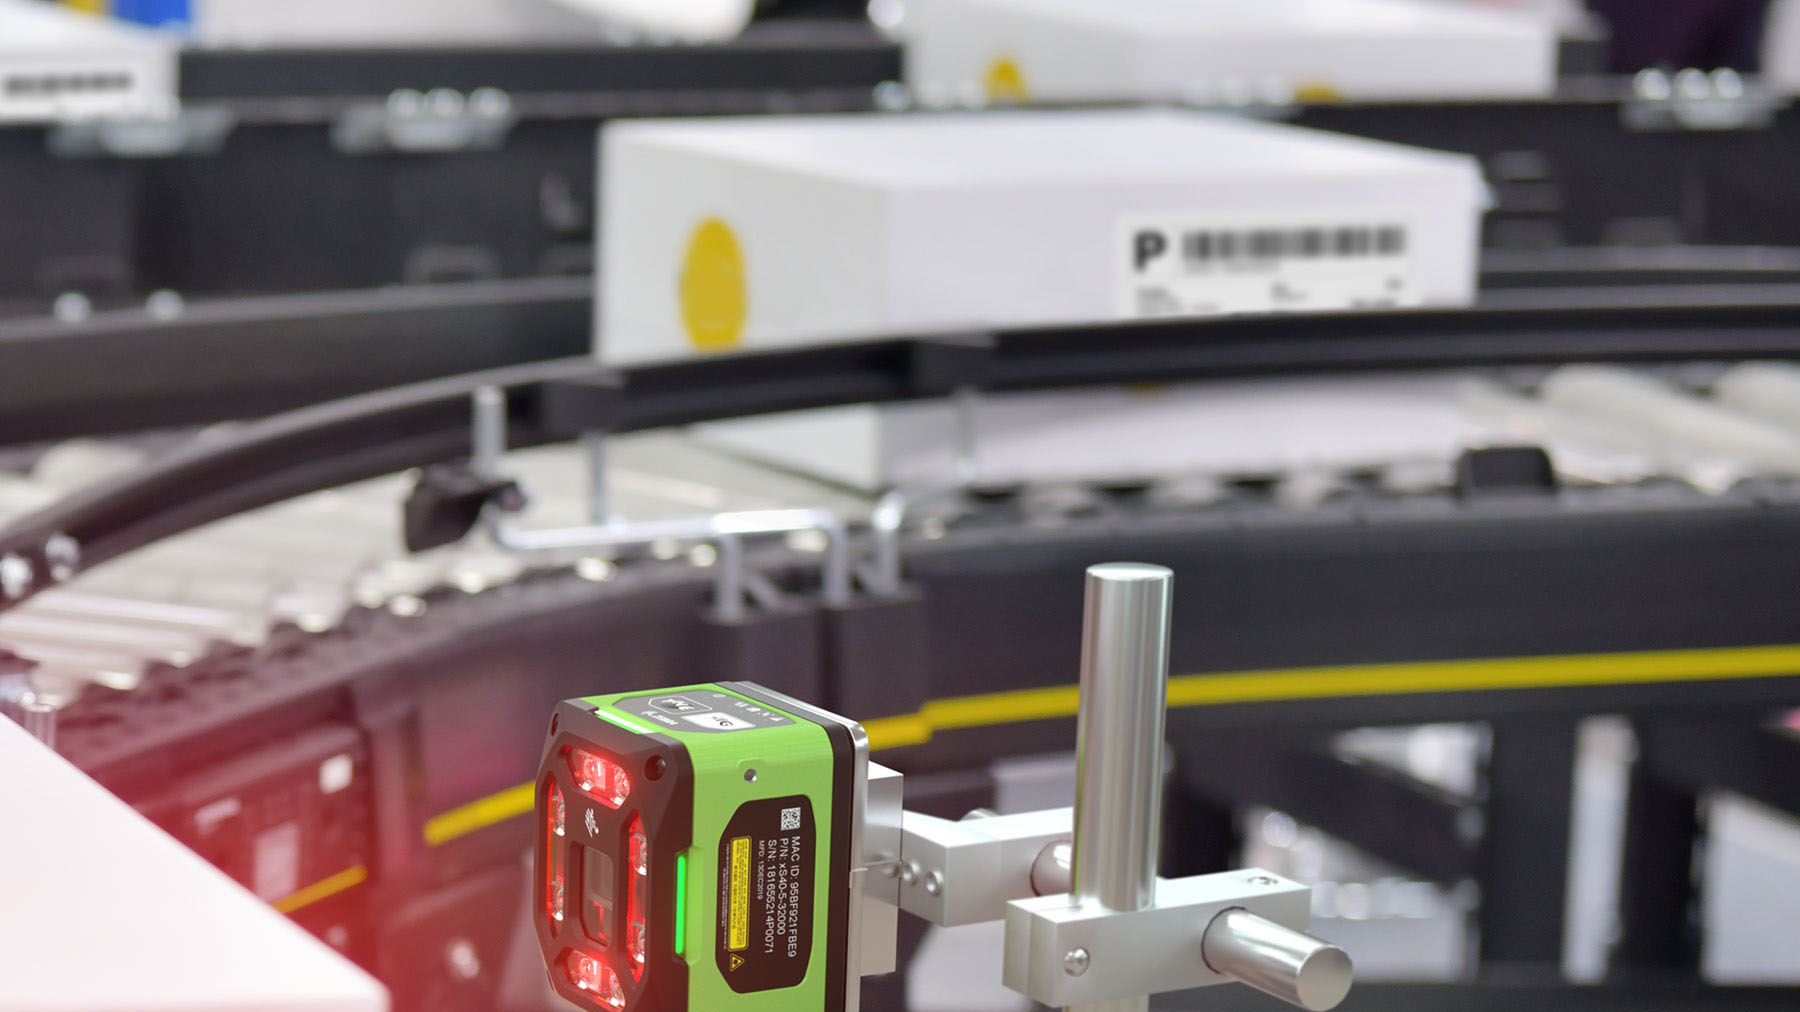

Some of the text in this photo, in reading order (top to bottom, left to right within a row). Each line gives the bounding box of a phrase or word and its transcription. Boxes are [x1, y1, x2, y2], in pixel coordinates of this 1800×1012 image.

[1134, 231, 1167, 271] P
[764, 839, 777, 954] S/N: 181655214P0071
[776, 837, 789, 936] P/N: xS40-5-32000
[787, 835, 801, 958] MAC ID: 95BF921FBE9
